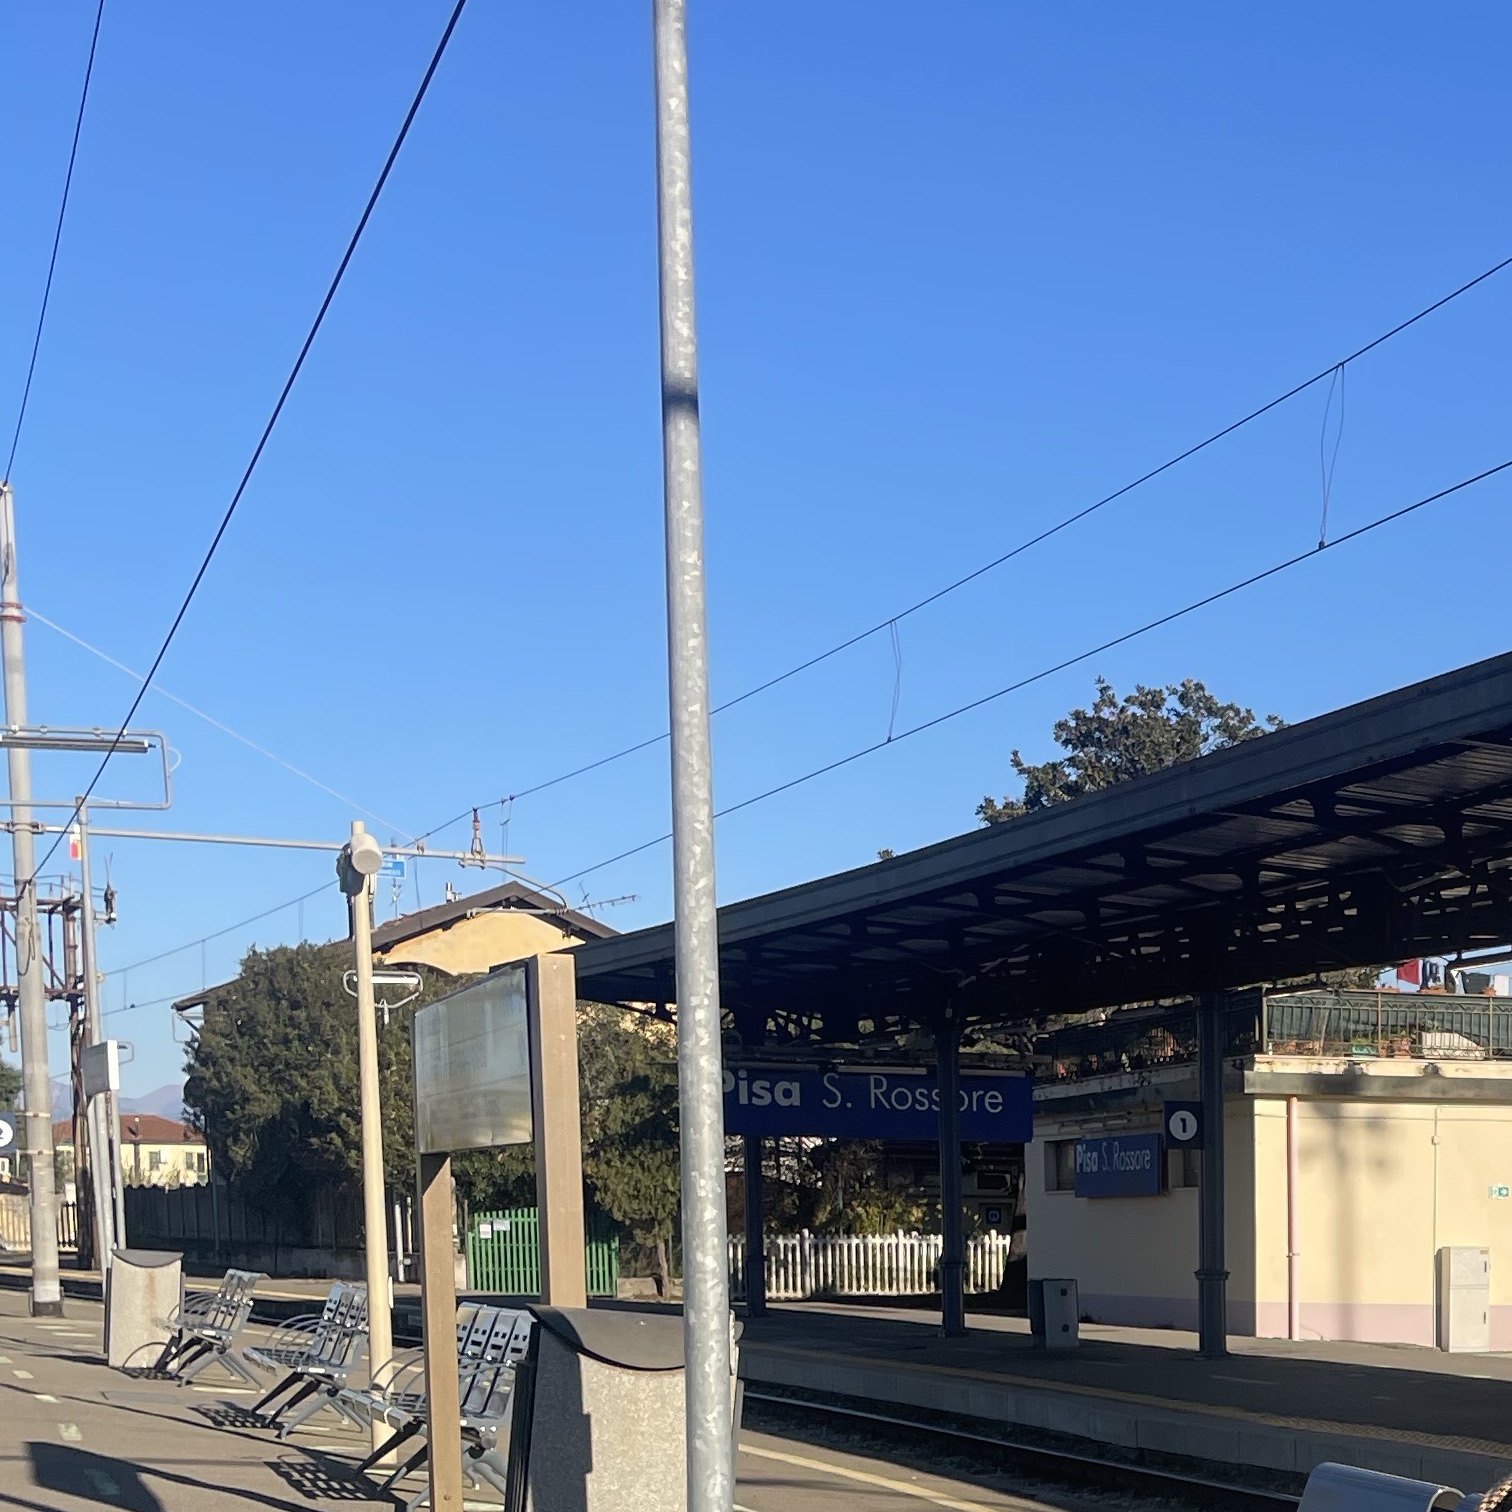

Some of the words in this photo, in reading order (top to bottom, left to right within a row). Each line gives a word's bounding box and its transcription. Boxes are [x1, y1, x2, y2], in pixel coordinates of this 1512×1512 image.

[822, 1072, 852, 1109] S.
[1076, 1143, 1099, 1173] Pisa
[1113, 1141, 1151, 1171] Rossore
